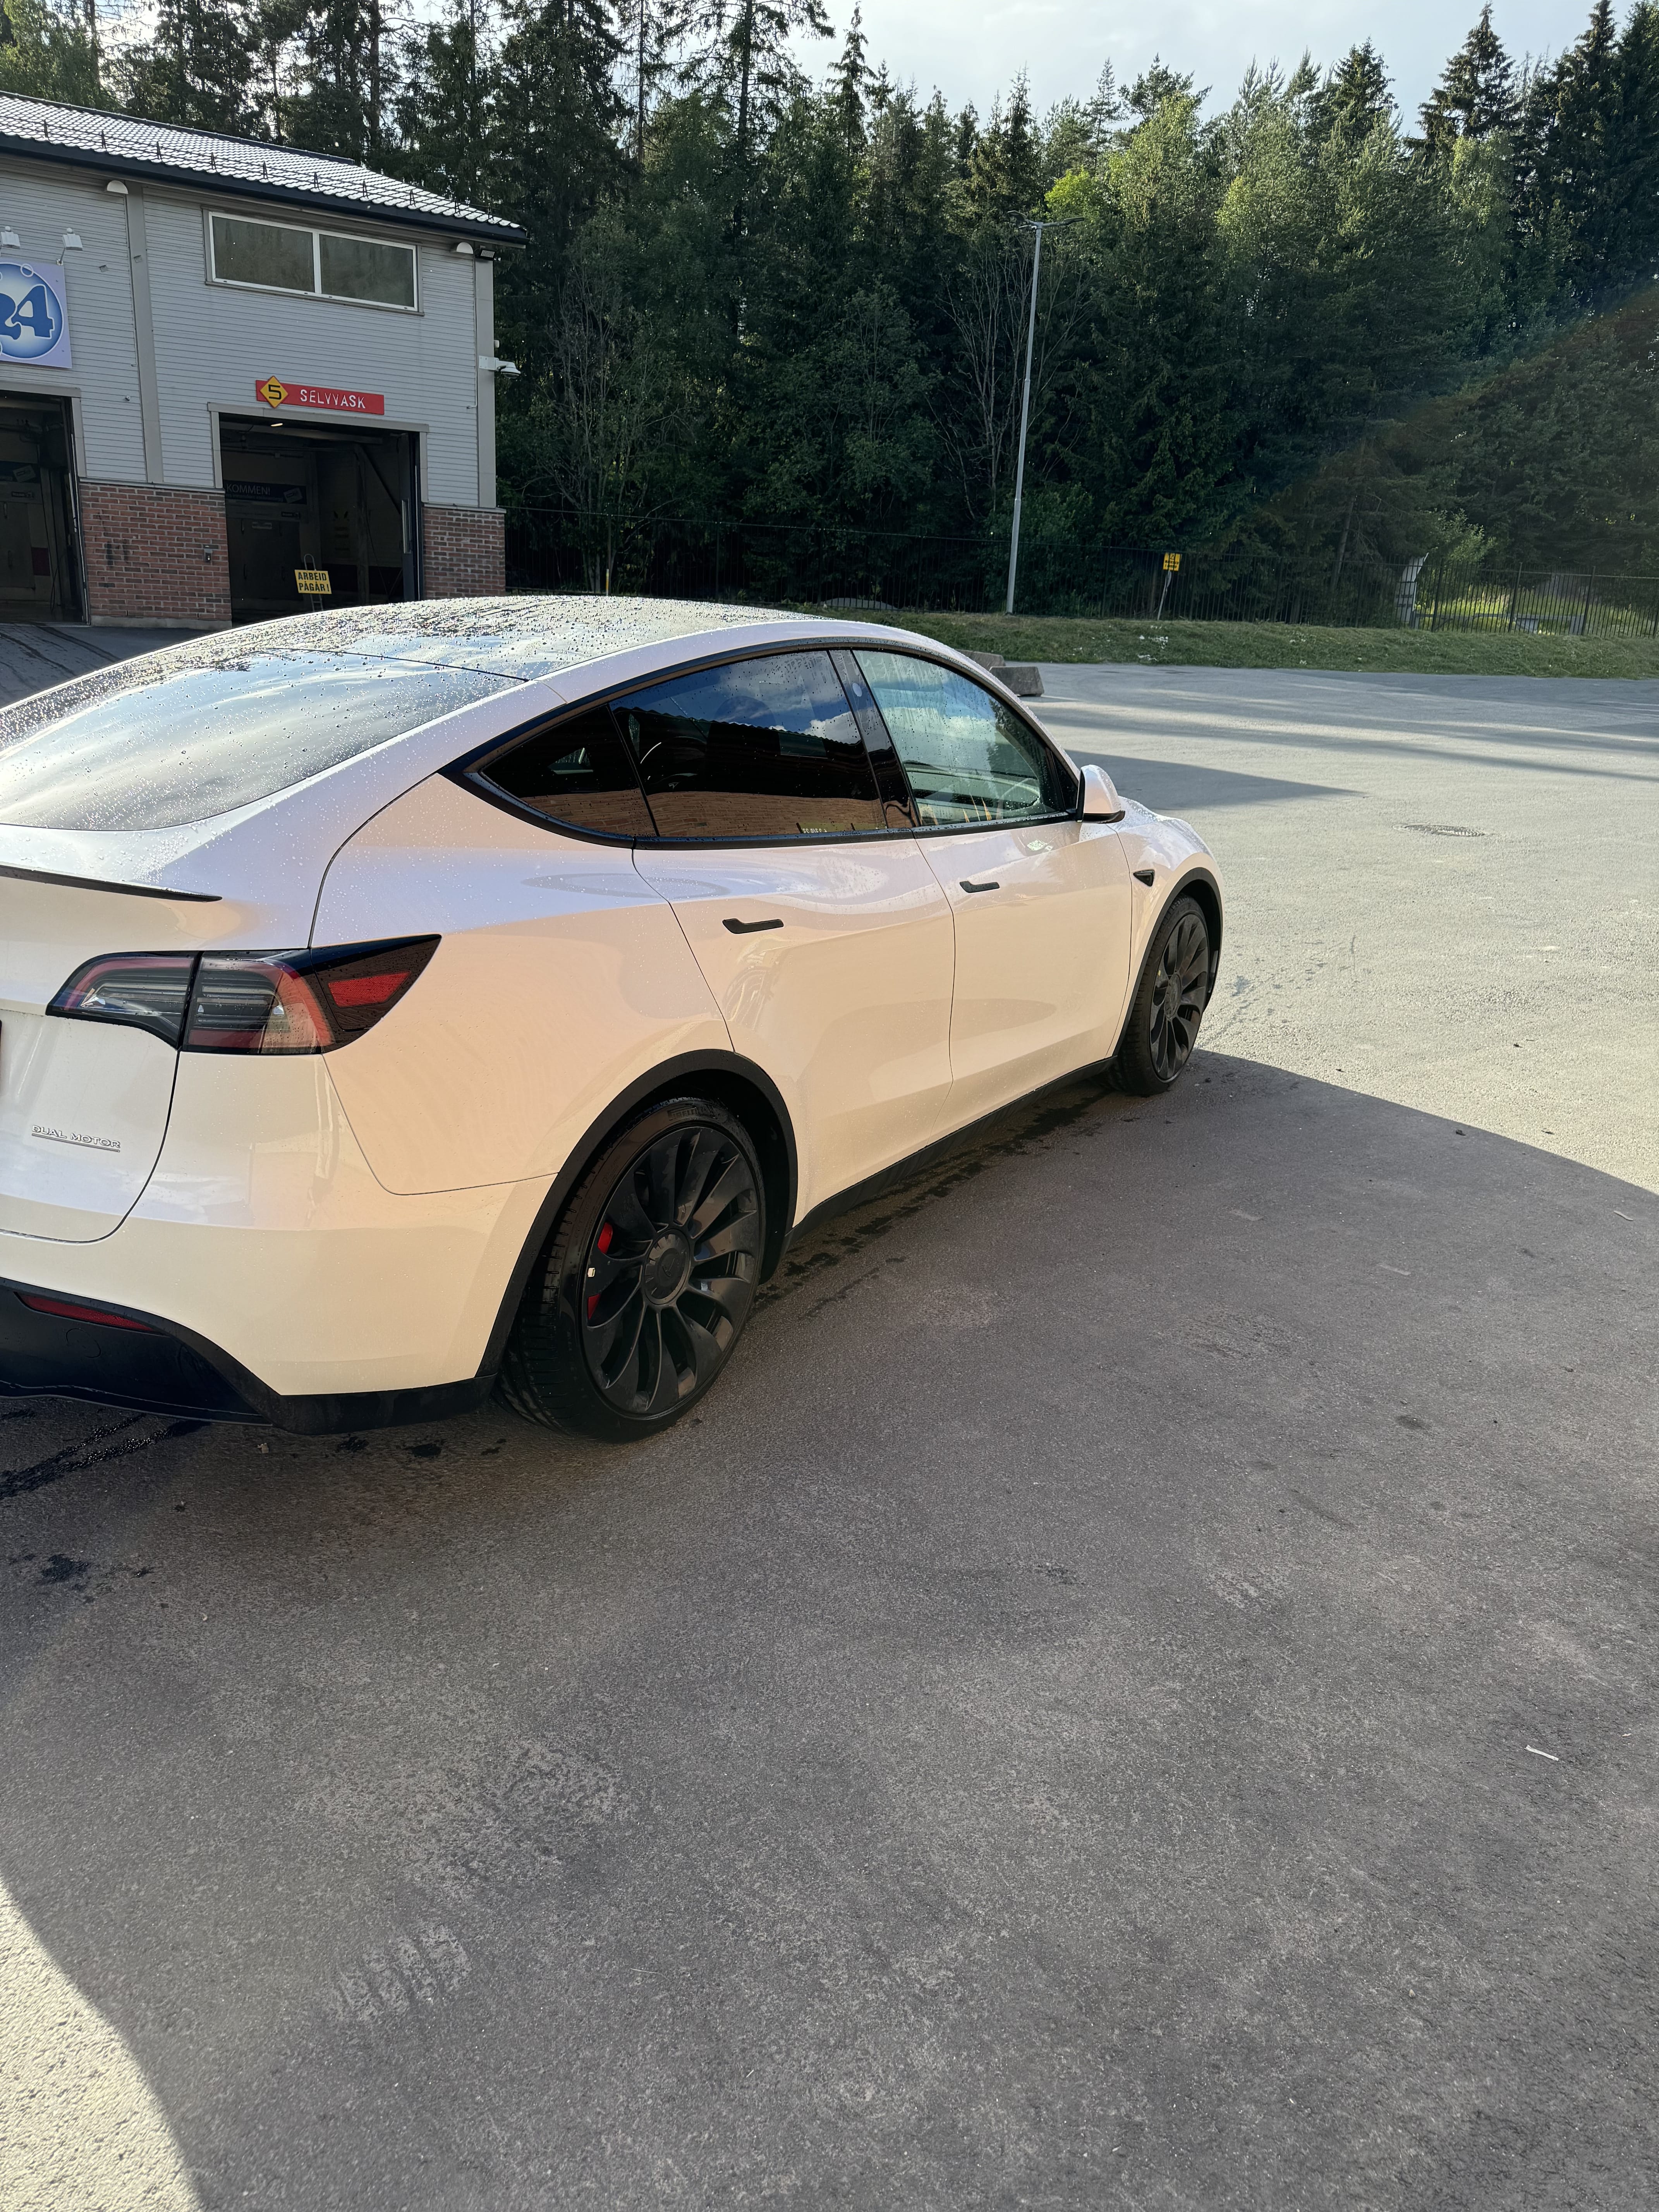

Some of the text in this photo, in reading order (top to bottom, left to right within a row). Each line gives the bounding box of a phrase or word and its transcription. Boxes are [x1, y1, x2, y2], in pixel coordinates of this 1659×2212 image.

[300, 389, 366, 409] SELVVASK
[226, 483, 270, 496] KOMMEN!
[298, 572, 327, 581] ARBEID
[32, 1125, 120, 1148] DUAL MOTOR
